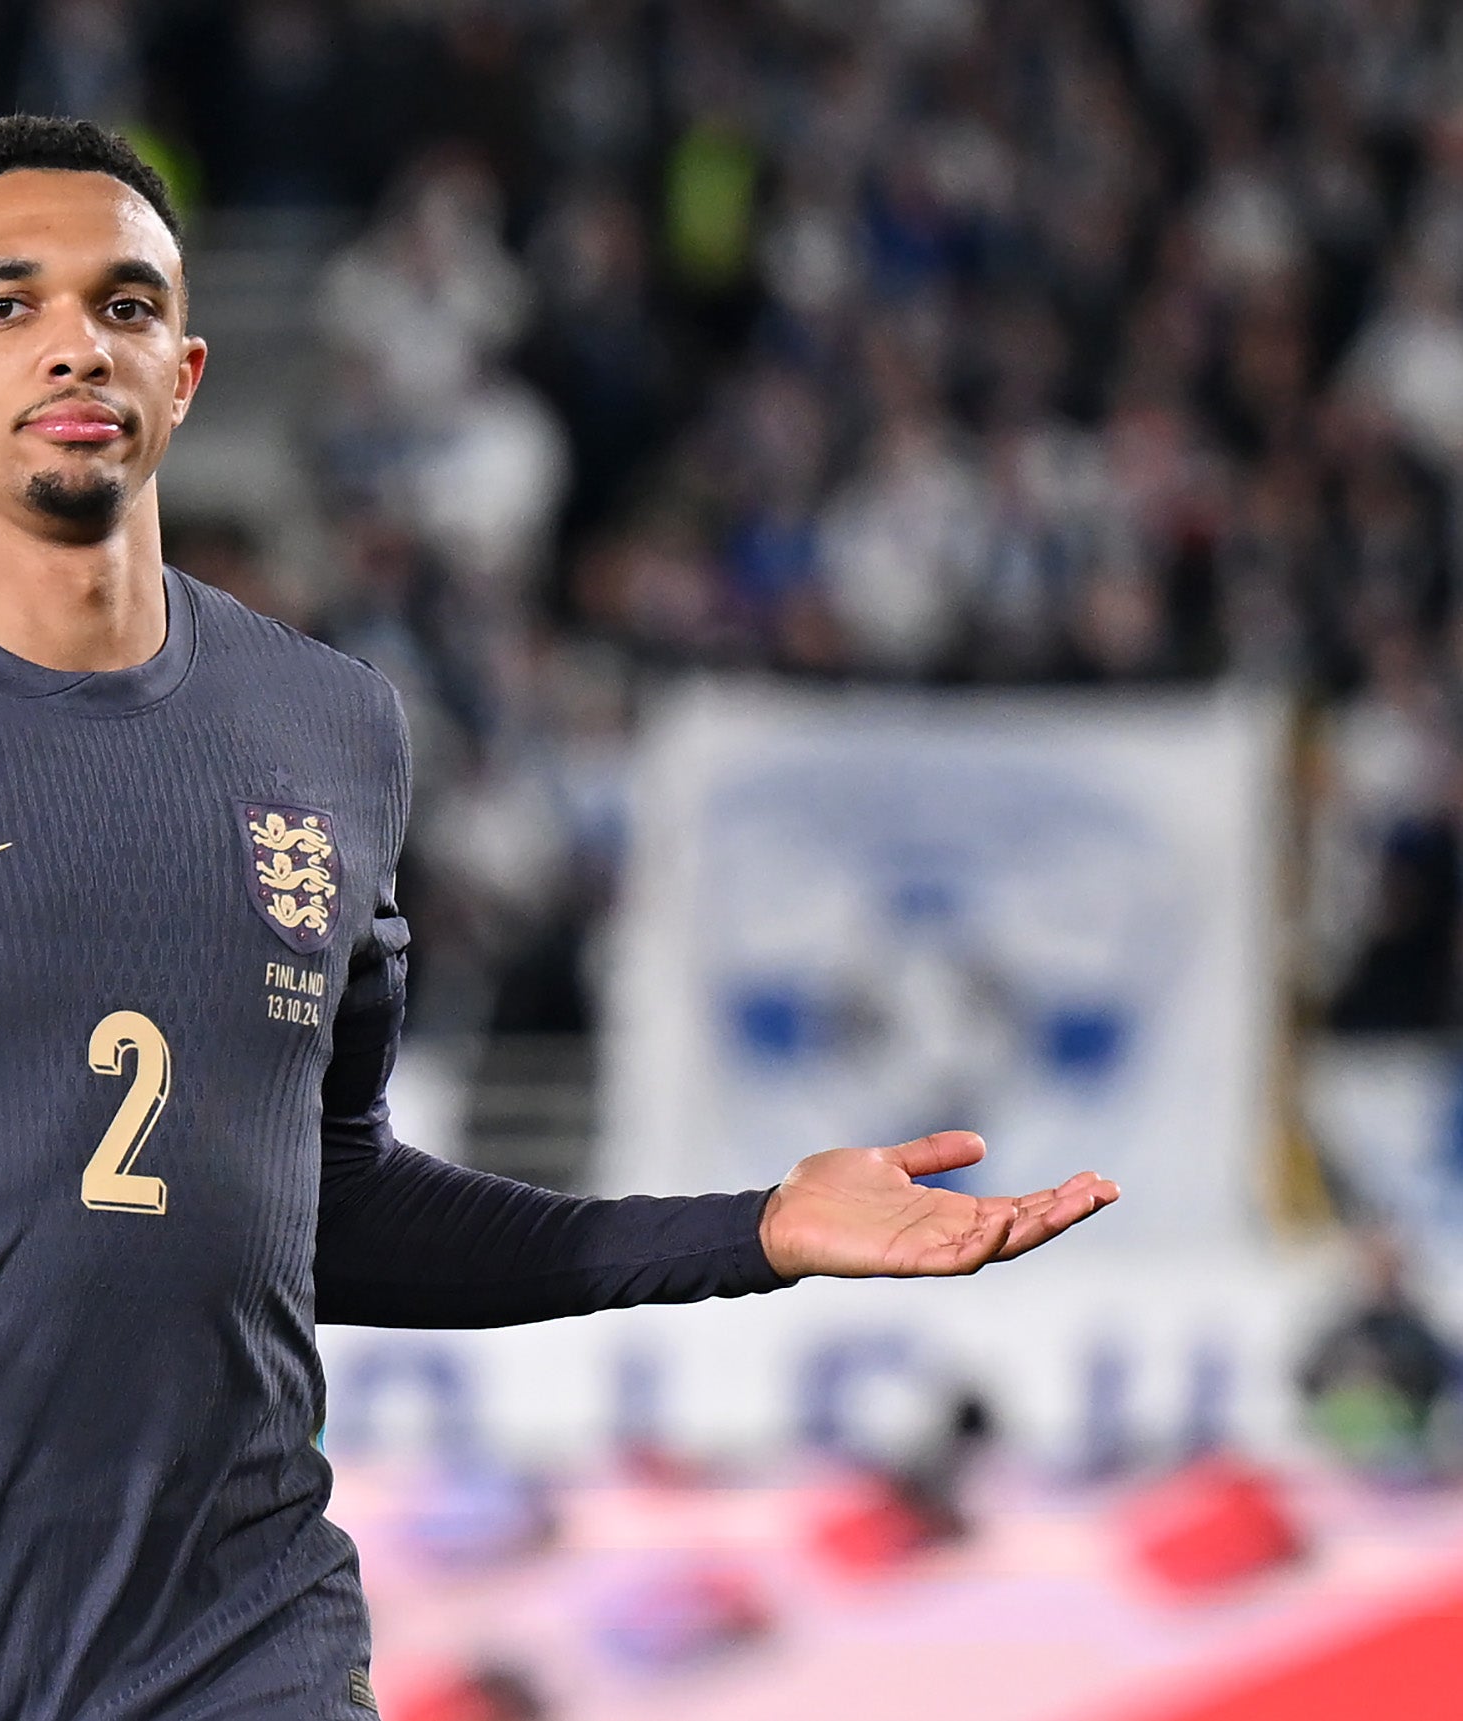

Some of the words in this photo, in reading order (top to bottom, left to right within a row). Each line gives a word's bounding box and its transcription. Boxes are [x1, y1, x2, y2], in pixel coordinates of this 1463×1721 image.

[265, 962, 323, 997] FINLAND
[267, 994, 318, 1027] 13.10.24
[80, 1010, 172, 1215] 2
